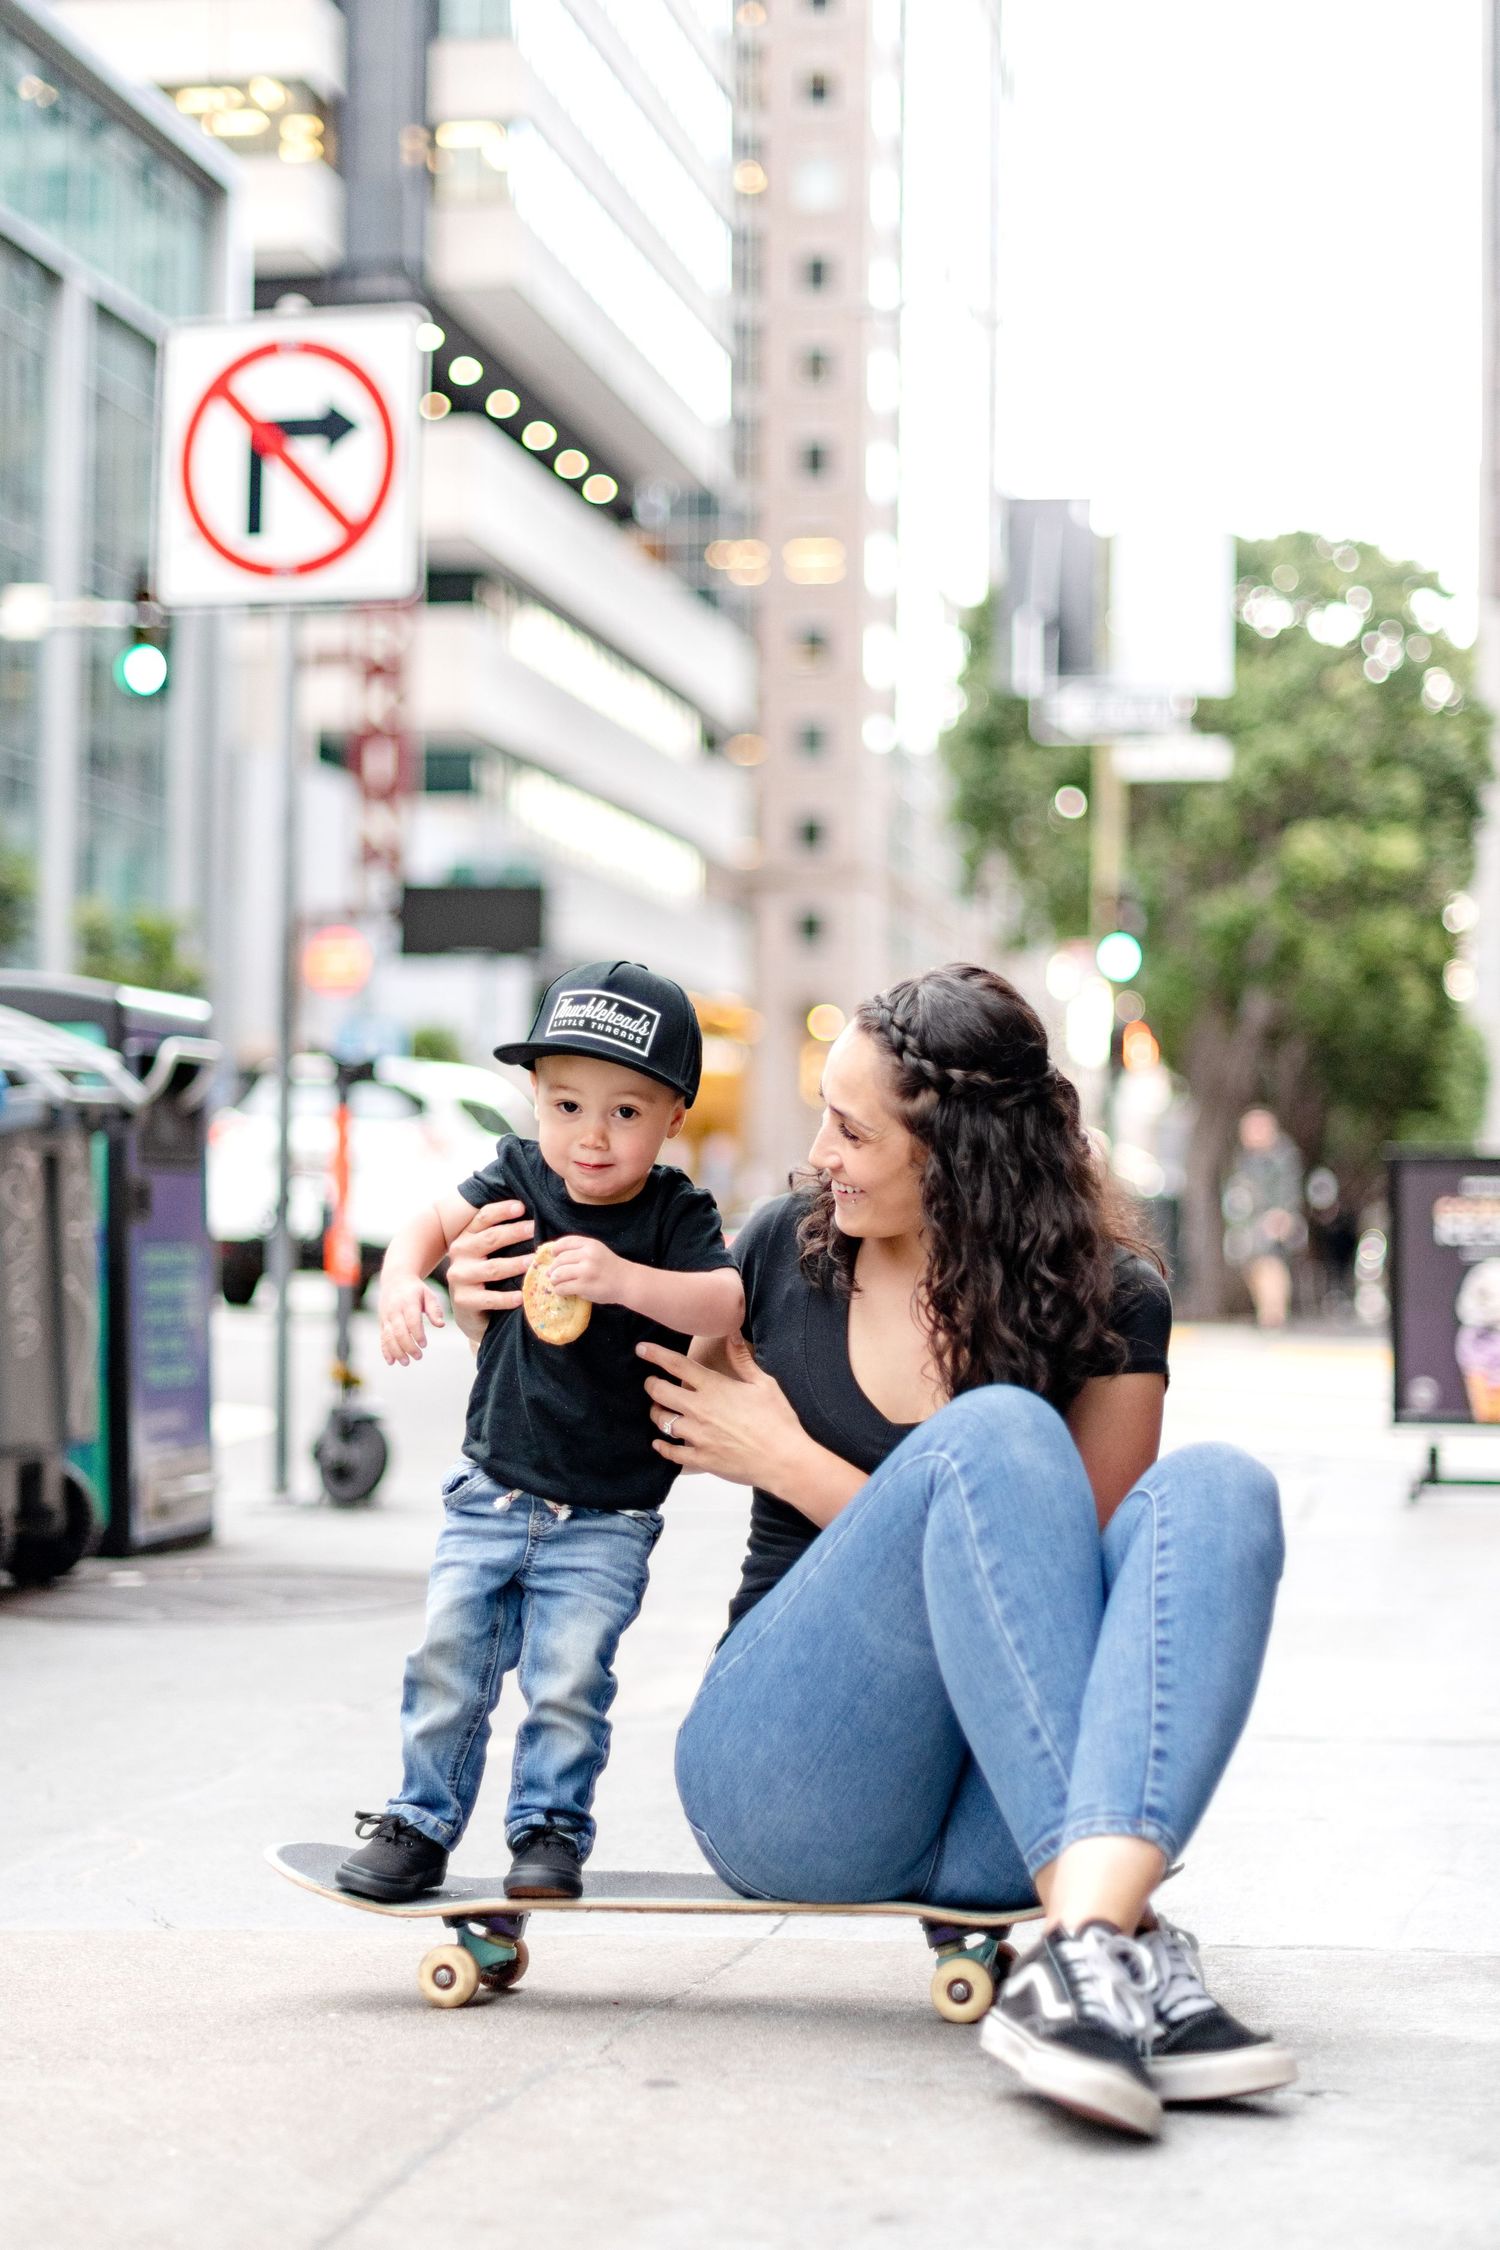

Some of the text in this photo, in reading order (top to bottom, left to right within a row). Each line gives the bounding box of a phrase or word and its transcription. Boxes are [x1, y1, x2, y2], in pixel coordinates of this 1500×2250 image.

[553, 1019, 642, 1044] LITTLE THREADS
[555, 997, 650, 1036] Knuckleheads
